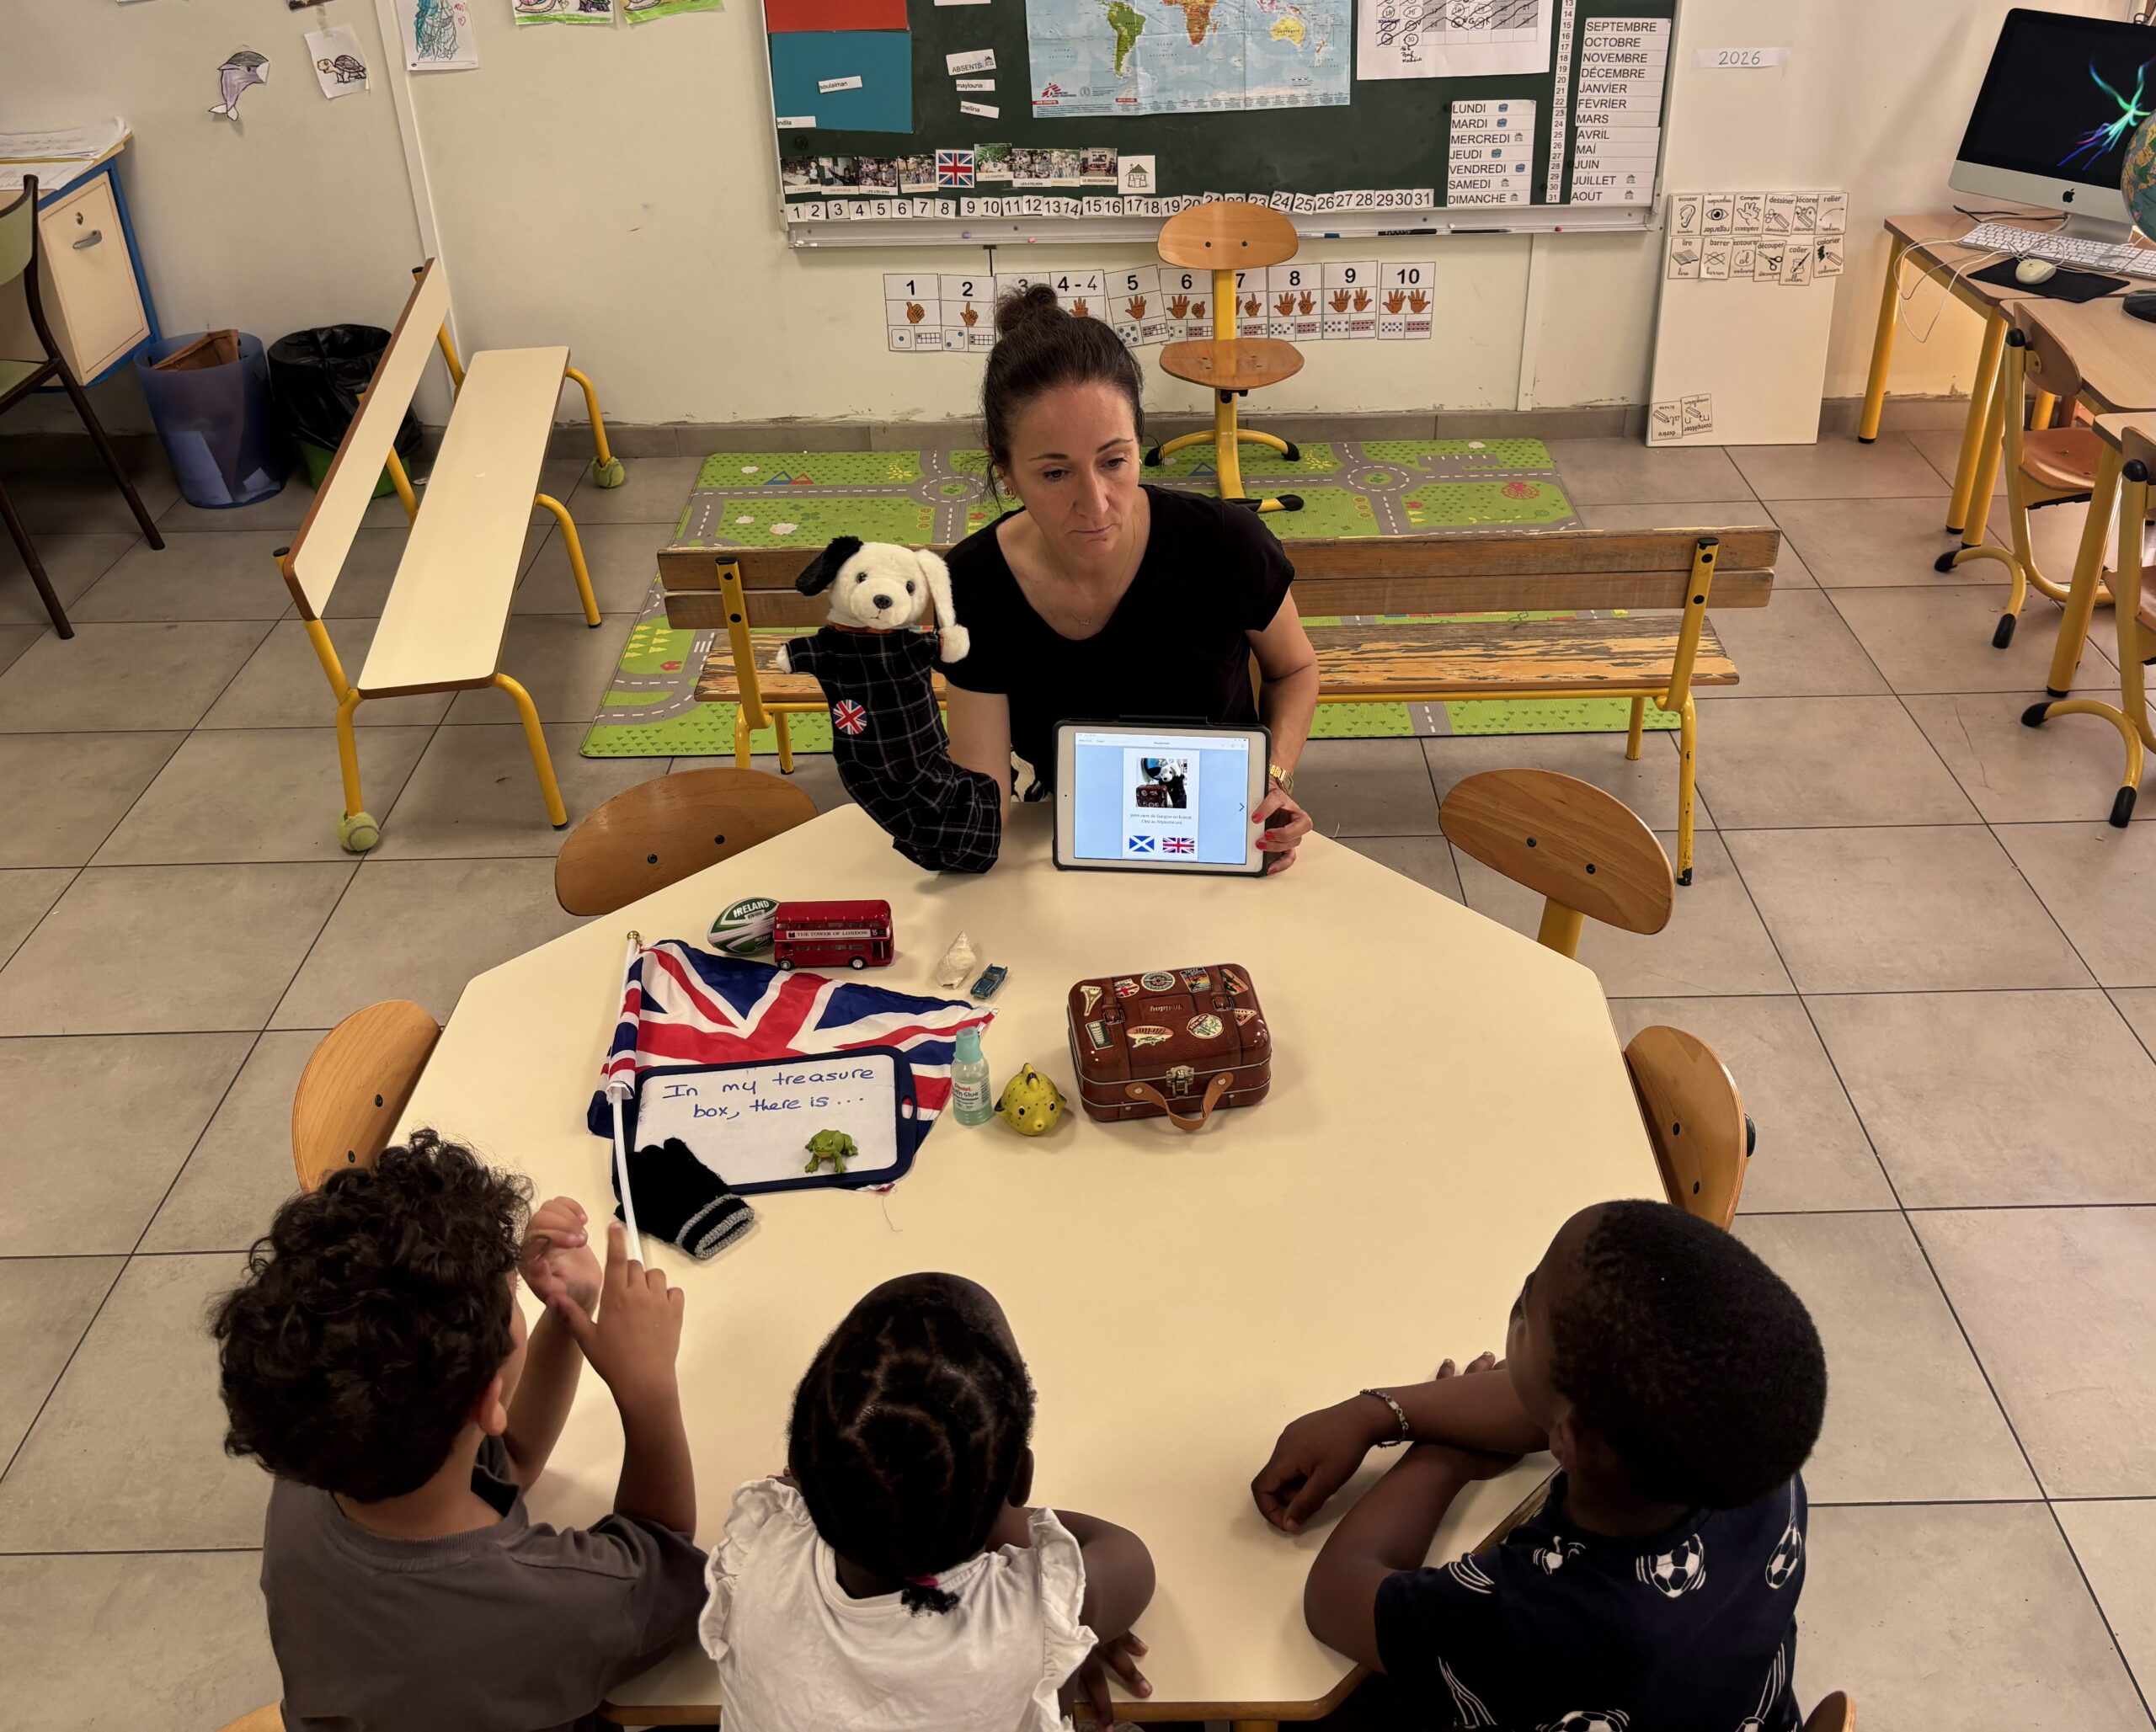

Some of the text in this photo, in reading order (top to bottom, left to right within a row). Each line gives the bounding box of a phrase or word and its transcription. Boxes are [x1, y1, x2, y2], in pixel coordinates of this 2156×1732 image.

[1587, 22, 1657, 32] SEPTEMBRE
[1585, 37, 1641, 47] OCTOBRE
[1582, 53, 1648, 63] NOVEMBRE
[1719, 51, 1761, 65] 2026
[1581, 67, 1646, 78] DÉCEMBRE
[1453, 104, 1486, 114] LUNDI
[1452, 119, 1487, 129] MARDI
[1577, 115, 1609, 124] MARS
[1450, 134, 1510, 144] MERCREDI
[1449, 150, 1482, 159] JEUDI
[1449, 164, 1507, 174] VENDREDI
[1574, 160, 1599, 169] JUIN
[1449, 179, 1491, 189] SAMEDI
[794, 207, 800, 218] 1
[811, 205, 819, 216] 2
[834, 204, 843, 216] 3
[856, 204, 864, 216] 4
[877, 203, 885, 215] 5
[898, 203, 906, 215] 6
[920, 202, 928, 213] 7
[941, 202, 949, 215] 8
[967, 201, 975, 213] 9
[984, 201, 1000, 213] 10
[1006, 200, 1020, 213] 11
[1026, 199, 1042, 211] 12
[1045, 201, 1060, 213] 13
[1064, 201, 1079, 216] 14
[1086, 200, 1102, 212] 15
[1105, 201, 1120, 213] 16
[1127, 200, 1141, 212] 17
[1144, 201, 1159, 213] 18
[1164, 200, 1180, 213] 19
[1273, 194, 1289, 209] 24
[1295, 196, 1312, 211] 25
[1317, 197, 1334, 210] 26
[1337, 195, 1353, 206] 27
[1356, 194, 1372, 206] 28
[1377, 194, 1393, 206] 29
[1396, 193, 1412, 205] 30
[1415, 193, 1430, 205] 31
[1448, 194, 1507, 204] DIMANCHE
[1057, 276, 1070, 291] 4
[1087, 275, 1098, 290] 4
[1127, 274, 1138, 290] 5
[1181, 274, 1193, 290] 6
[1236, 273, 1246, 289] 7
[1289, 270, 1301, 286] 8
[1345, 268, 1356, 284] 9
[1397, 269, 1420, 284] 10
[906, 280, 915, 296] 1
[962, 281, 974, 296] 2
[1018, 279, 1029, 294] 3
[733, 900, 770, 918] IRELAND
[1150, 1004, 1183, 1013] Holiday
[663, 1069, 875, 1099] In my treasure
[693, 1104, 739, 1120] box,
[750, 1099, 802, 1112] there
